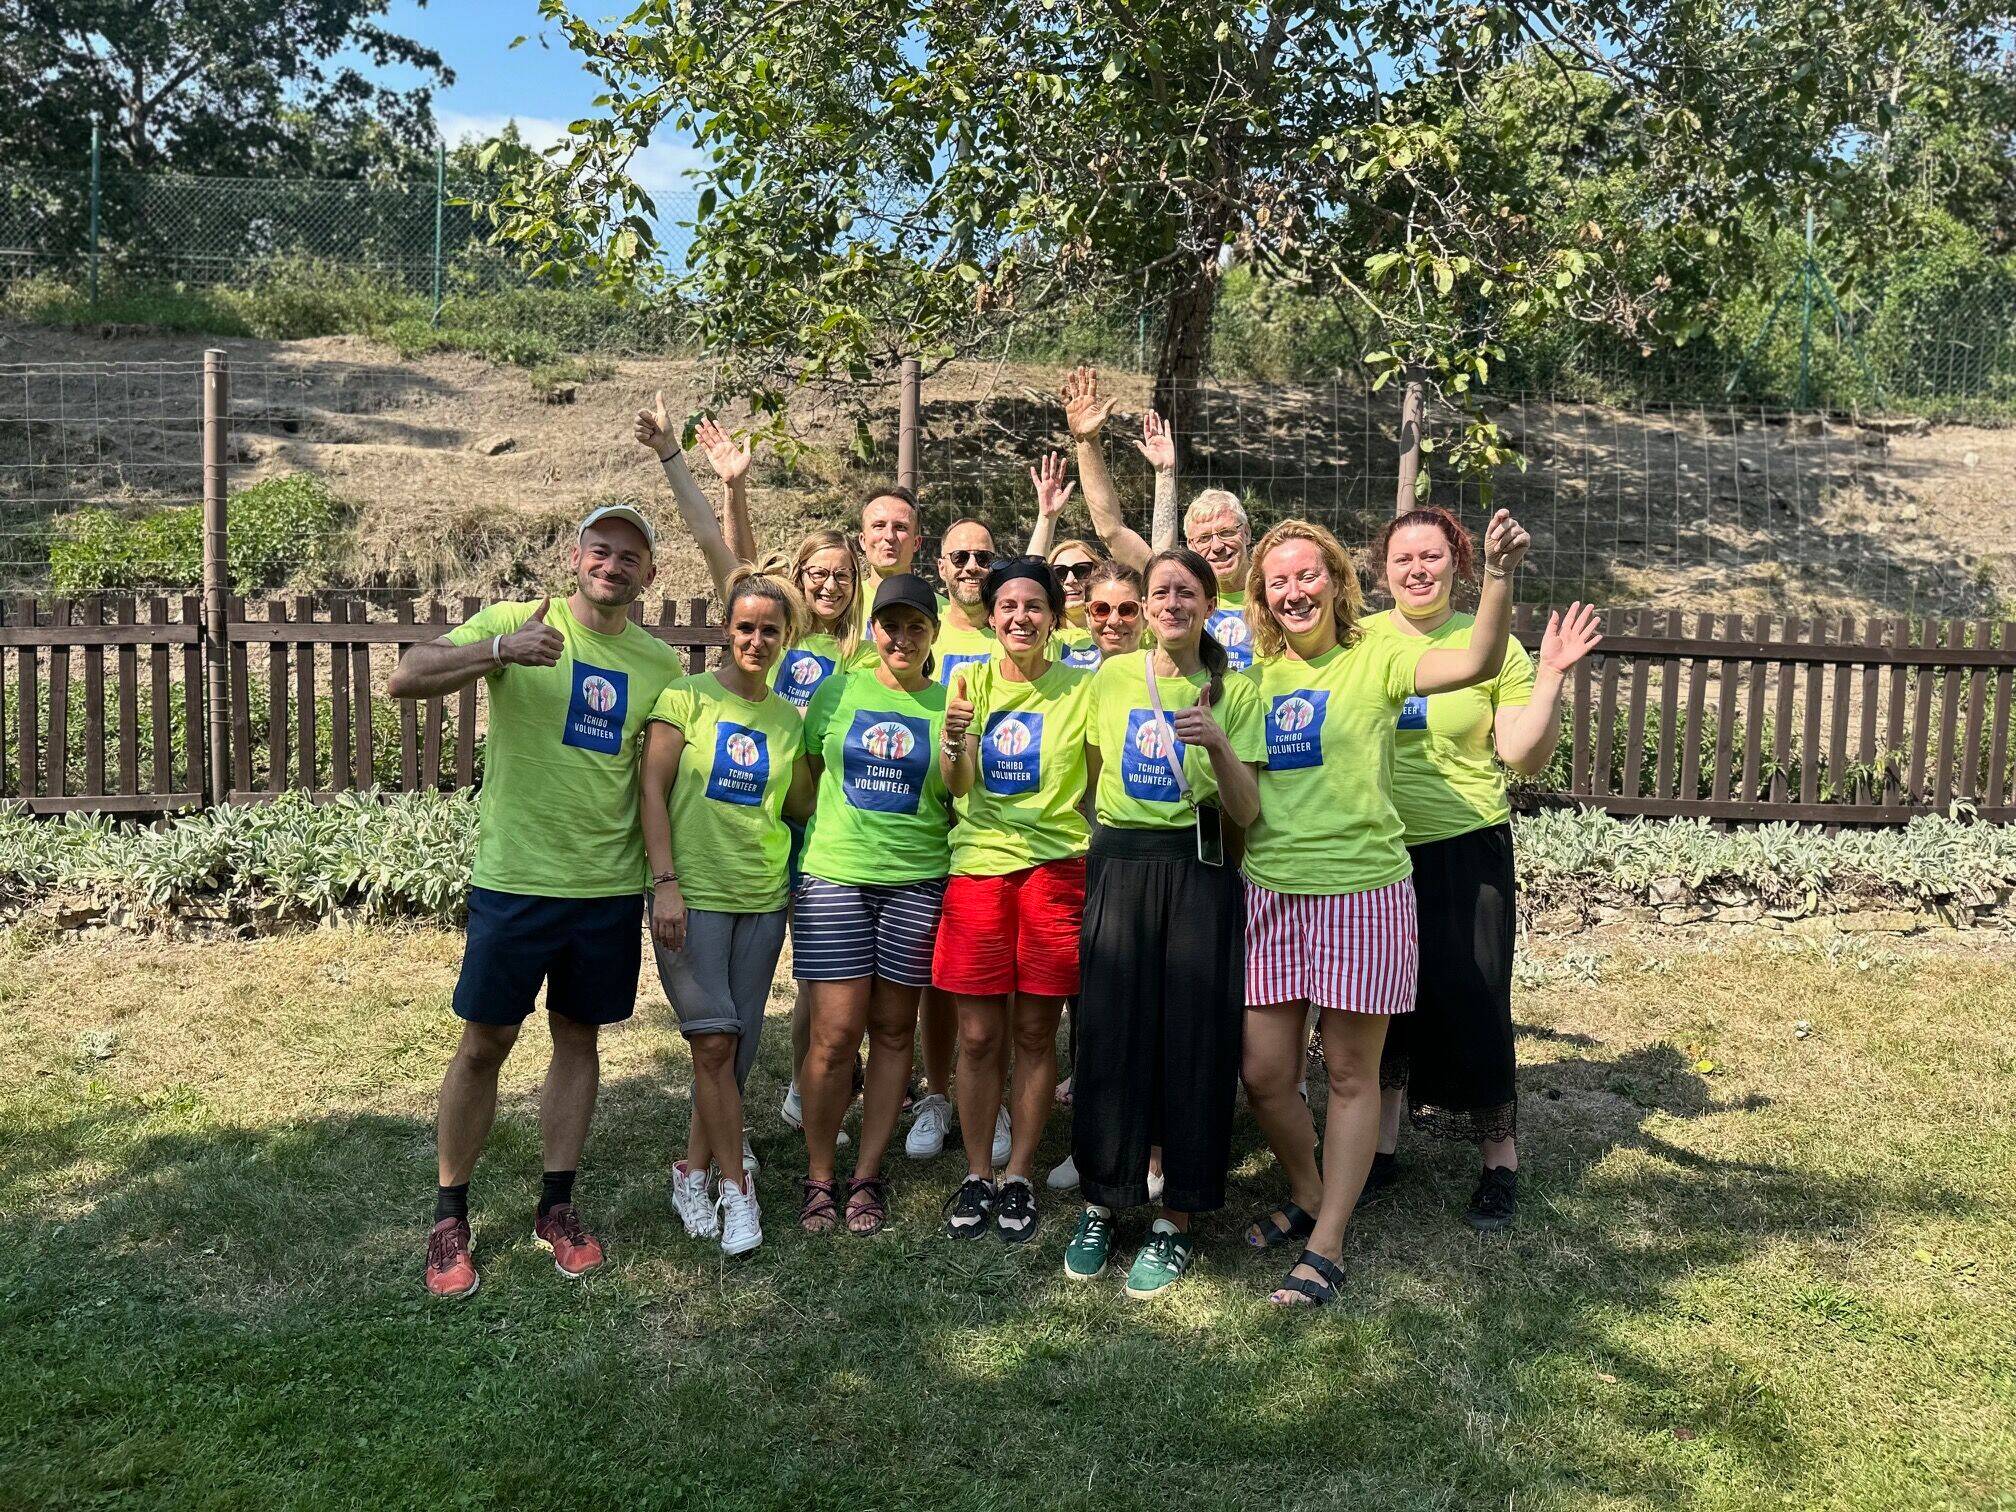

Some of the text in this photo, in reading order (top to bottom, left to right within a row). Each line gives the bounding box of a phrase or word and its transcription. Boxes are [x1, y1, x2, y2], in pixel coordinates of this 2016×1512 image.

[778, 690, 810, 707] VOLUNTEE
[787, 685, 810, 698] TCHIBO
[582, 713, 609, 728] TCHIBO
[574, 723, 614, 740] VOLUNTEER
[1275, 732, 1303, 743] TCHIBO
[1267, 741, 1311, 755] VOLUNTEER
[866, 764, 903, 780] TCHIBO
[996, 760, 1024, 771] TCHIBO
[1137, 762, 1166, 775] TCHIBO
[728, 767, 754, 781] TCHIBO
[990, 770, 1031, 781] VOLUNTEER
[1128, 772, 1173, 787] VOLUNTEER
[717, 777, 758, 793] VOLUNTEER
[854, 777, 910, 795] VOLUNTEER
